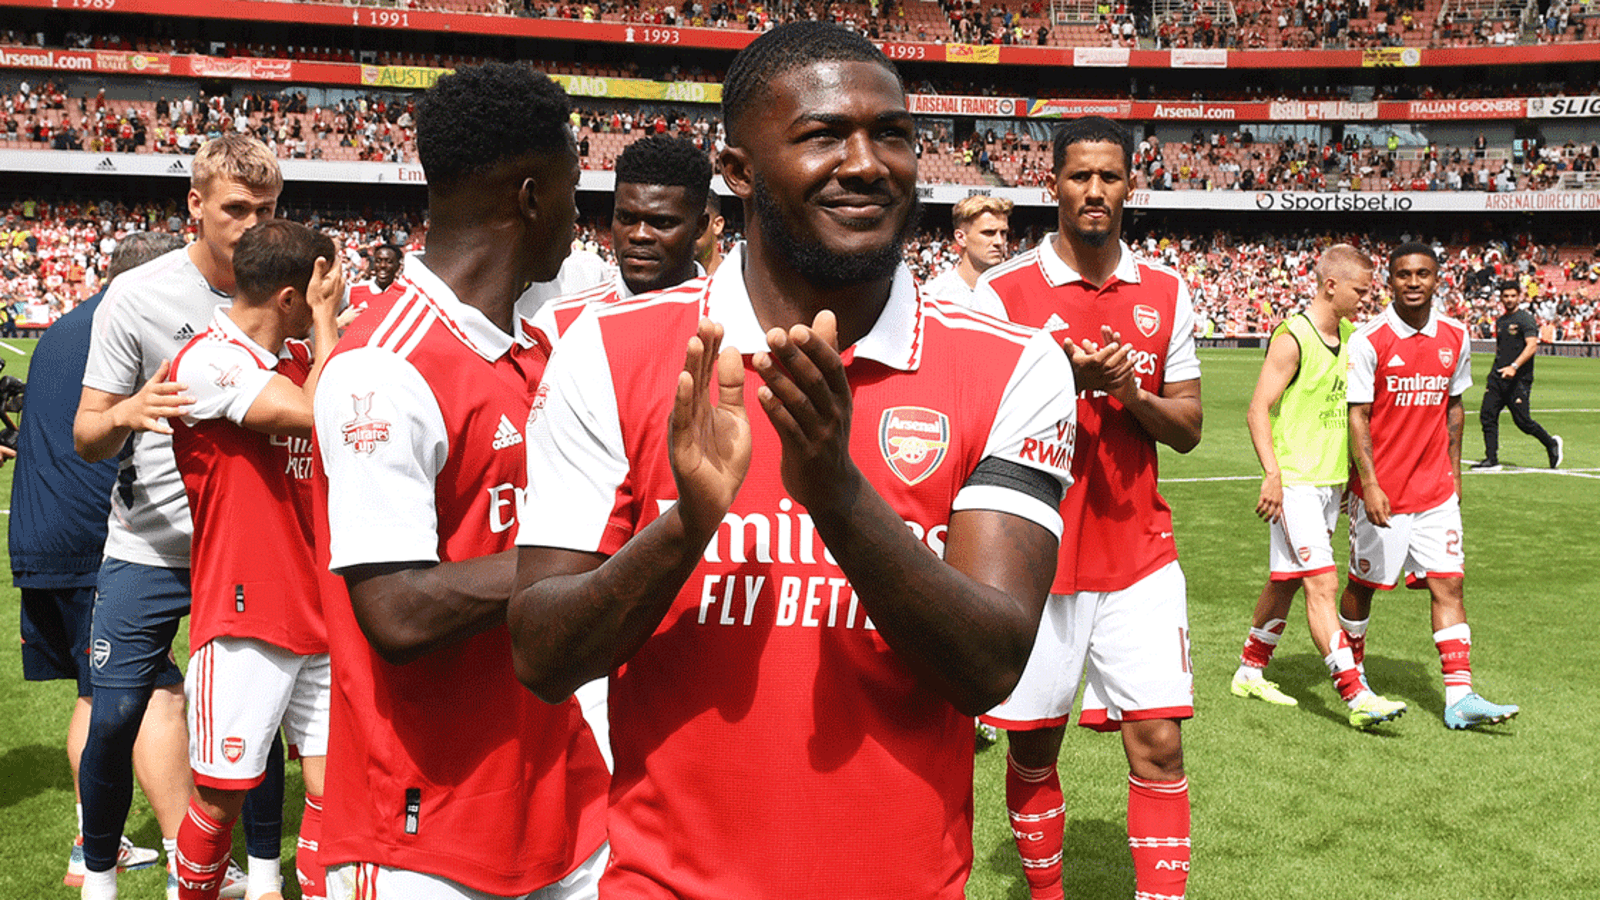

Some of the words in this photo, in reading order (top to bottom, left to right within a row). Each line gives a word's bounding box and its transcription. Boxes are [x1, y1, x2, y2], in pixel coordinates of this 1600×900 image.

[370, 11, 409, 27] 1991
[643, 29, 680, 44] 1993
[889, 45, 925, 60] 1993
[915, 95, 959, 113] ARSENAL
[961, 98, 998, 115] FRANCE
[1154, 104, 1236, 120] Arsenal.com
[1410, 101, 1456, 114] ITALIAN
[1458, 100, 1521, 113] GOONERS
[1281, 193, 1412, 211] Sportsbet.io
[889, 416, 941, 434] Arsenal
[698, 574, 765, 626] FLY
[776, 575, 877, 630] BETT
